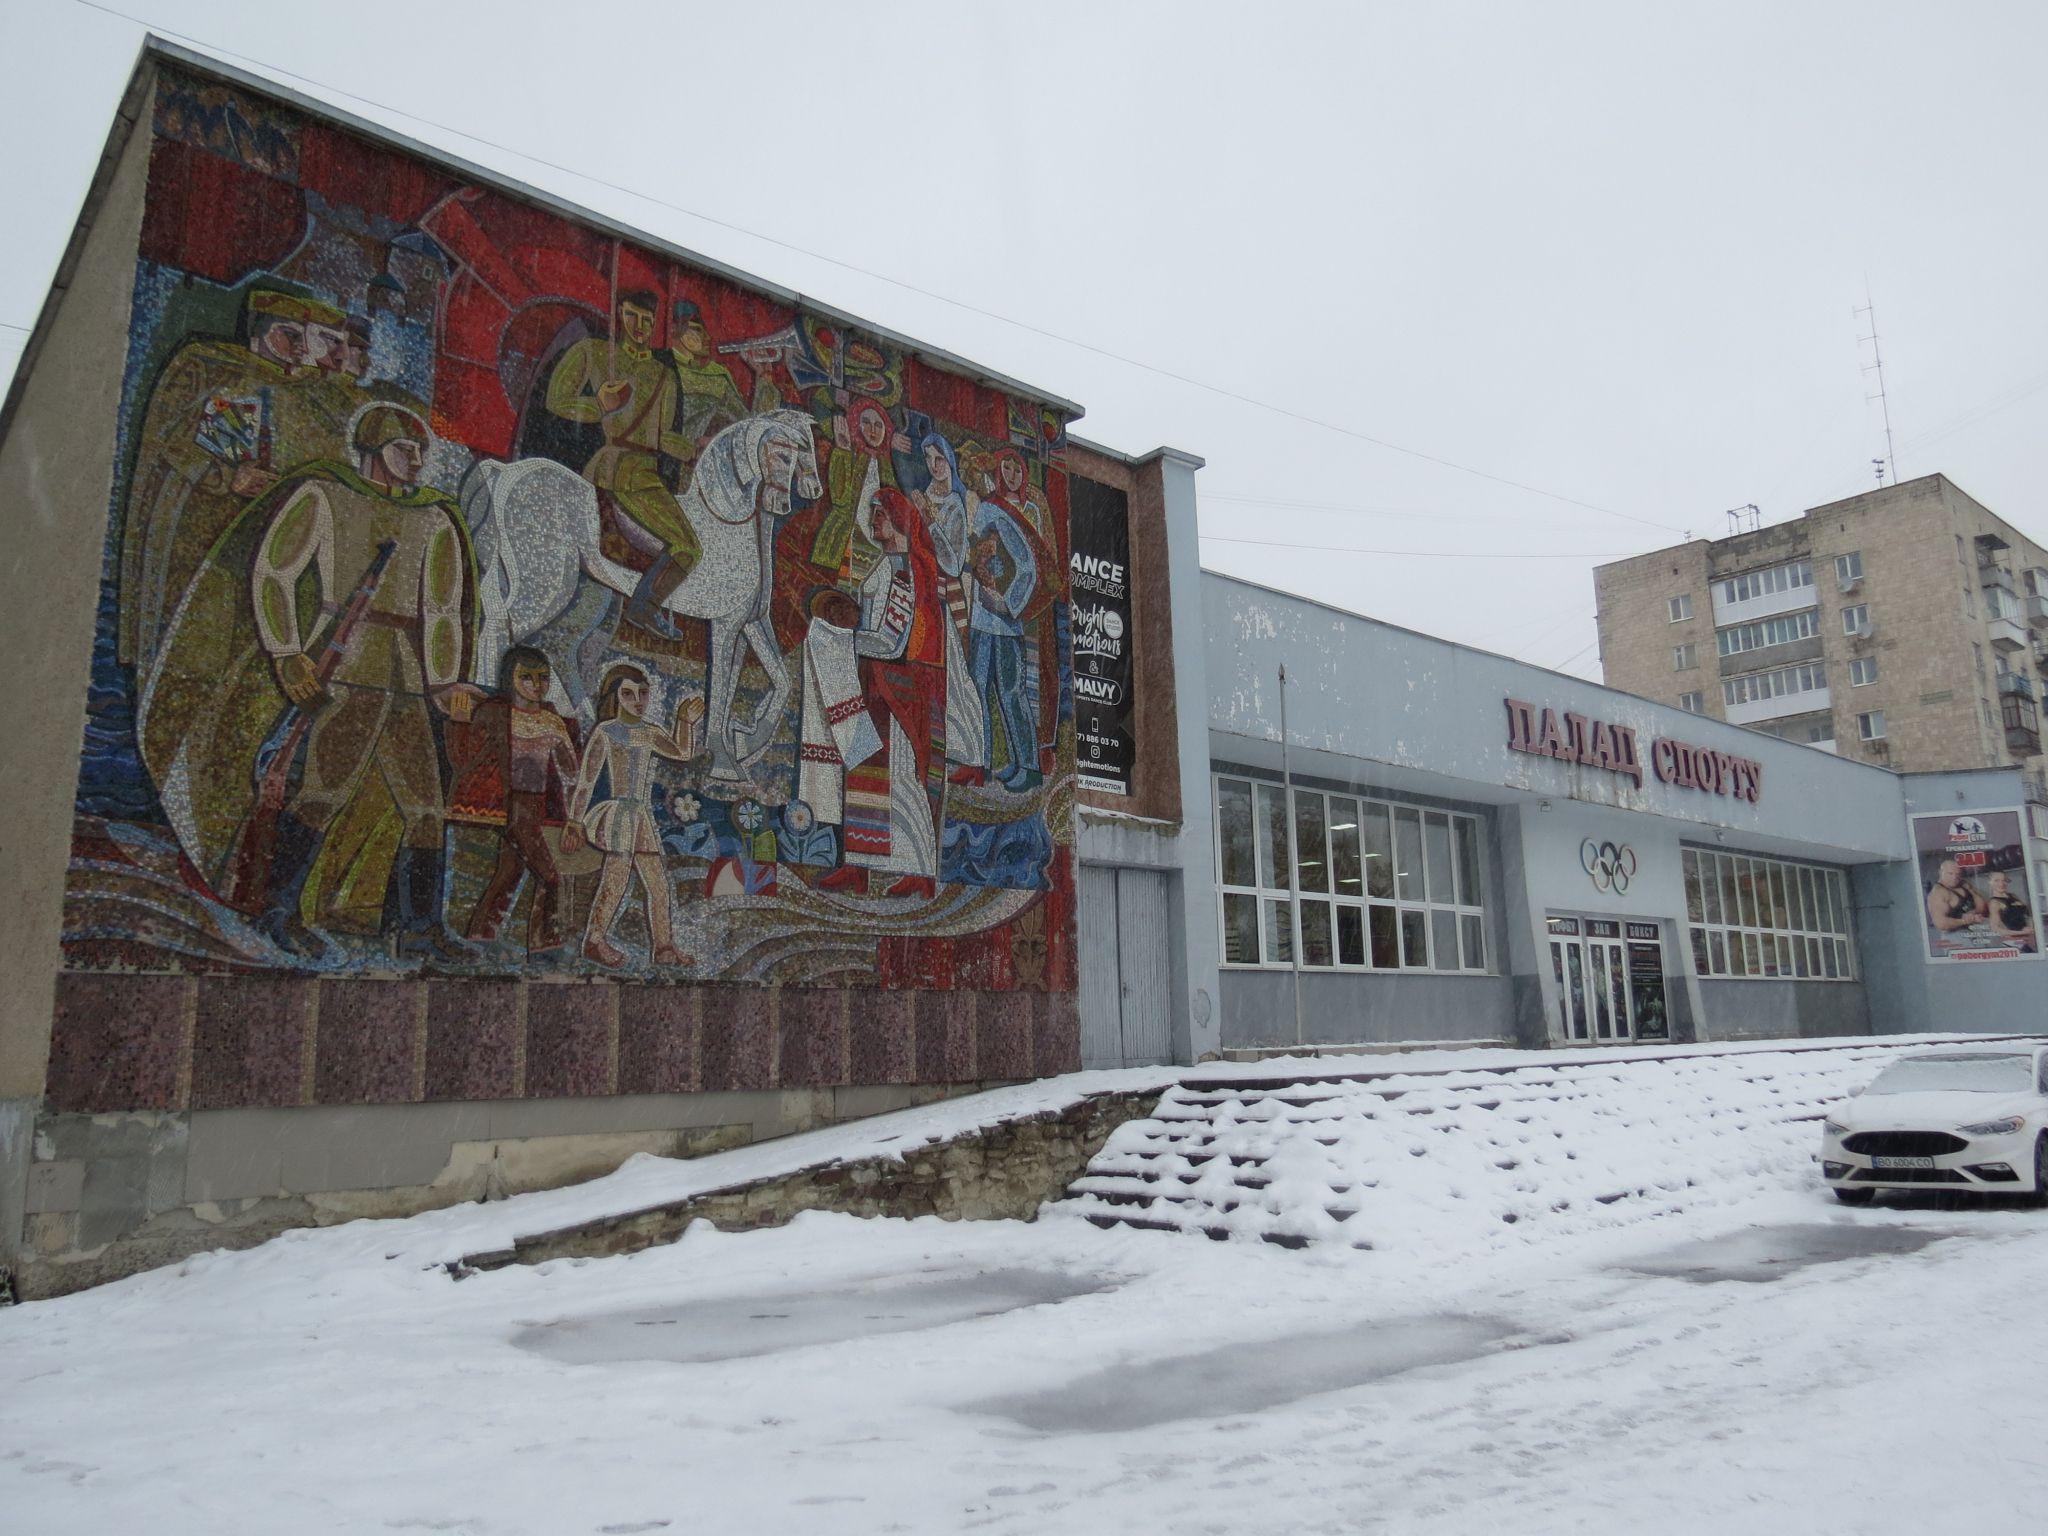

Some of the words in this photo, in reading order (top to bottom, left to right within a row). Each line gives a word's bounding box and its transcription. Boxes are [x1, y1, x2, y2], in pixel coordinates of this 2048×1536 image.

[1070, 552, 1124, 583] ANCE
[1070, 571, 1125, 599] OMPLEX
[1073, 630, 1121, 656] motions
[1089, 660, 1099, 674] &
[1073, 676, 1116, 700] MALVY
[1086, 734, 1099, 744] 886
[1100, 737, 1109, 746] 03
[1110, 739, 1119, 747] 70
[1504, 698, 1643, 789] ПАЛАЦ
[1652, 737, 1762, 803] СПОРТУ
[1077, 759, 1120, 773] ightemotions
[1084, 779, 1122, 791] PRODUCTION
